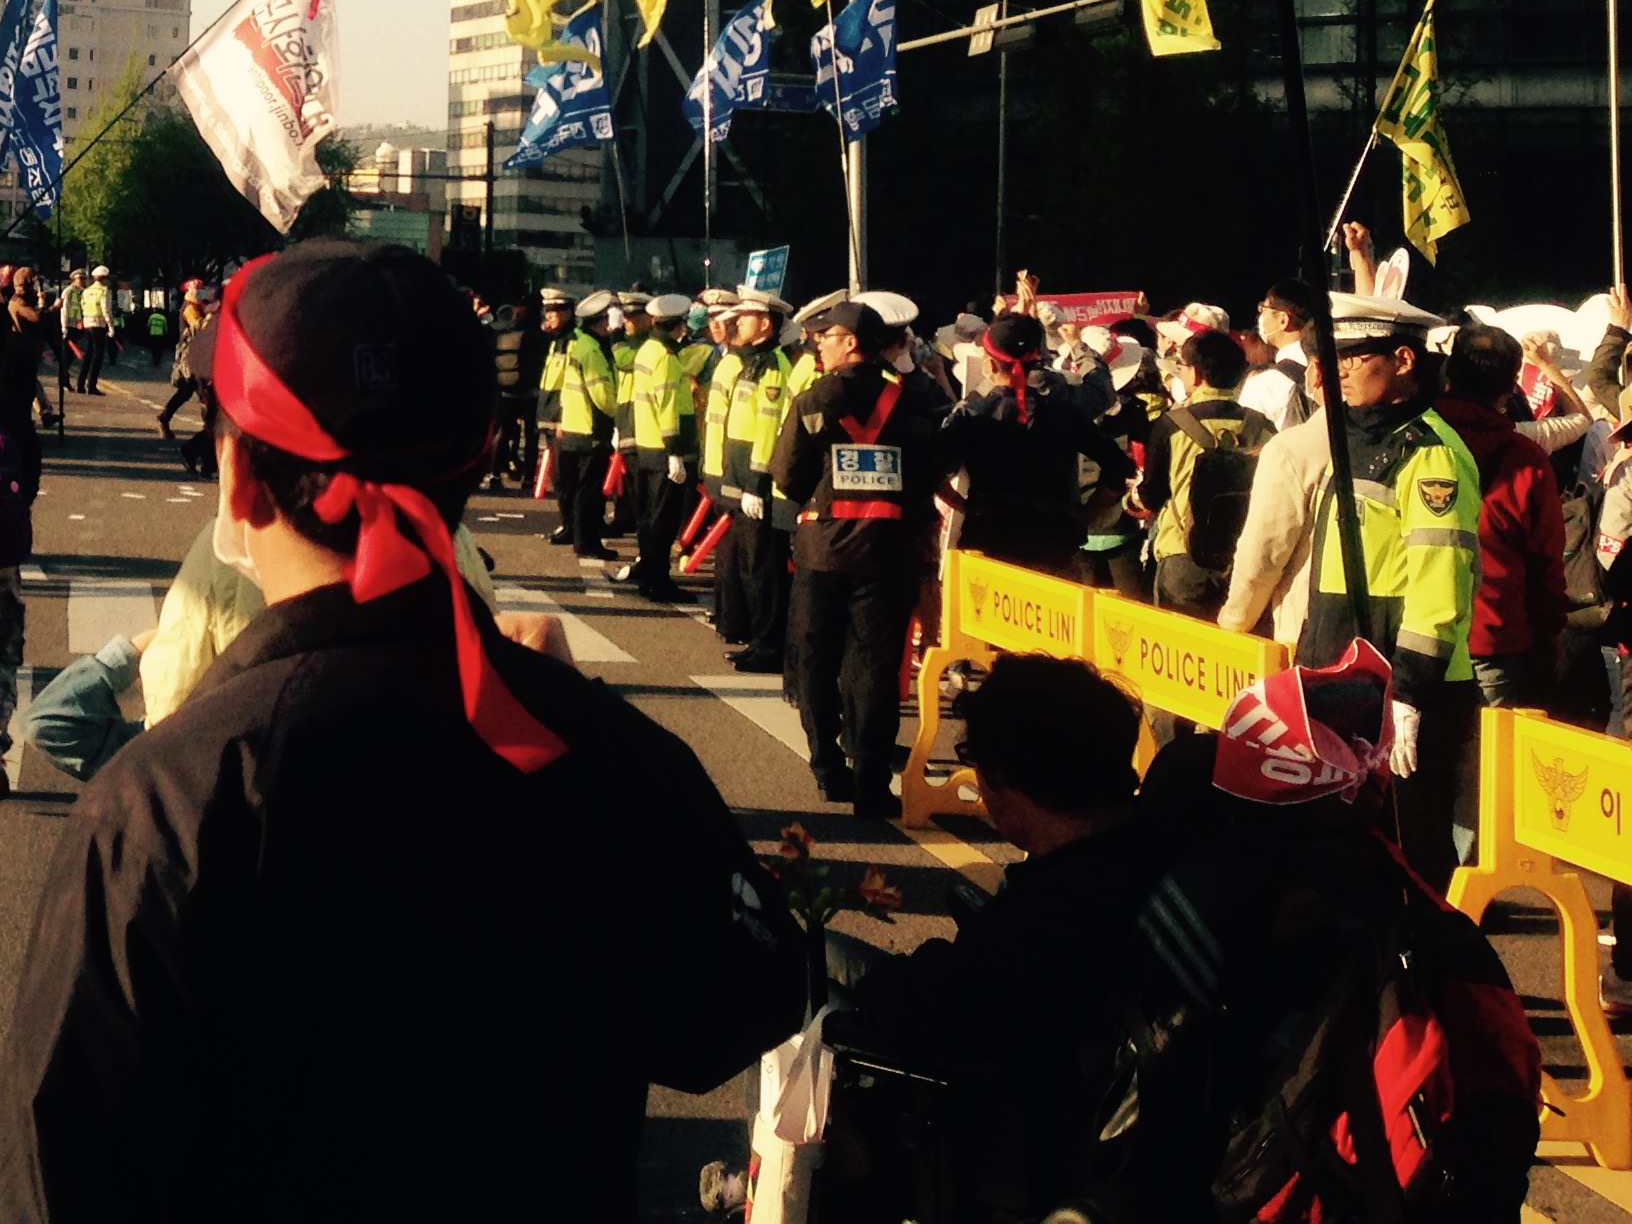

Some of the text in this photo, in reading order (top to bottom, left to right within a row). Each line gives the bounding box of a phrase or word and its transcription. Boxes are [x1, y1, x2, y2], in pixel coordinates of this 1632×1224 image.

[839, 450, 894, 472] 경찰
[840, 475, 895, 485] POLICE
[993, 590, 1043, 634] POLICE
[1139, 637, 1207, 692] POLICE
